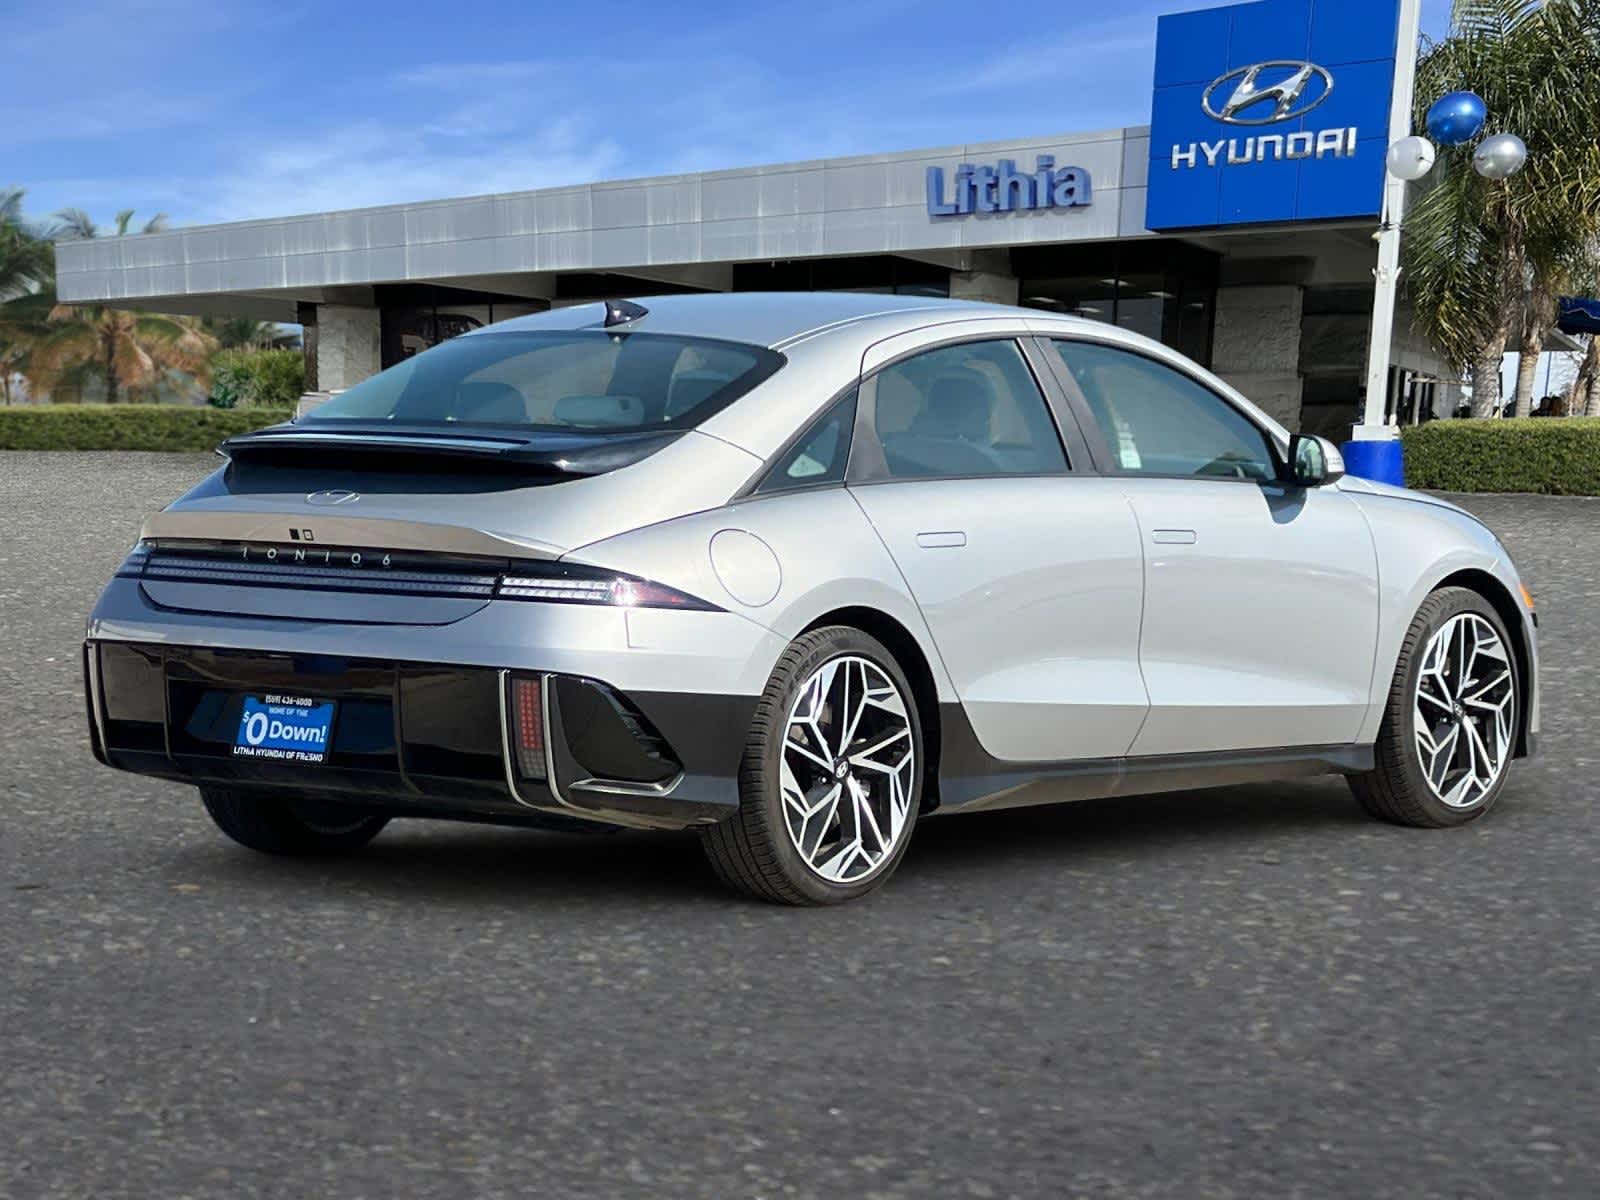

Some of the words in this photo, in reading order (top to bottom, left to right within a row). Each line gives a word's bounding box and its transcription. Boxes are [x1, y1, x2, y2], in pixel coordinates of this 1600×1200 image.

[1171, 127, 1357, 169] HYUNDAI
[926, 154, 1093, 217] Lithia
[269, 720, 327, 743] Down!
[233, 746, 254, 756] LITHIA
[255, 748, 285, 759] HYUNDAI
[286, 751, 296, 759] OF
